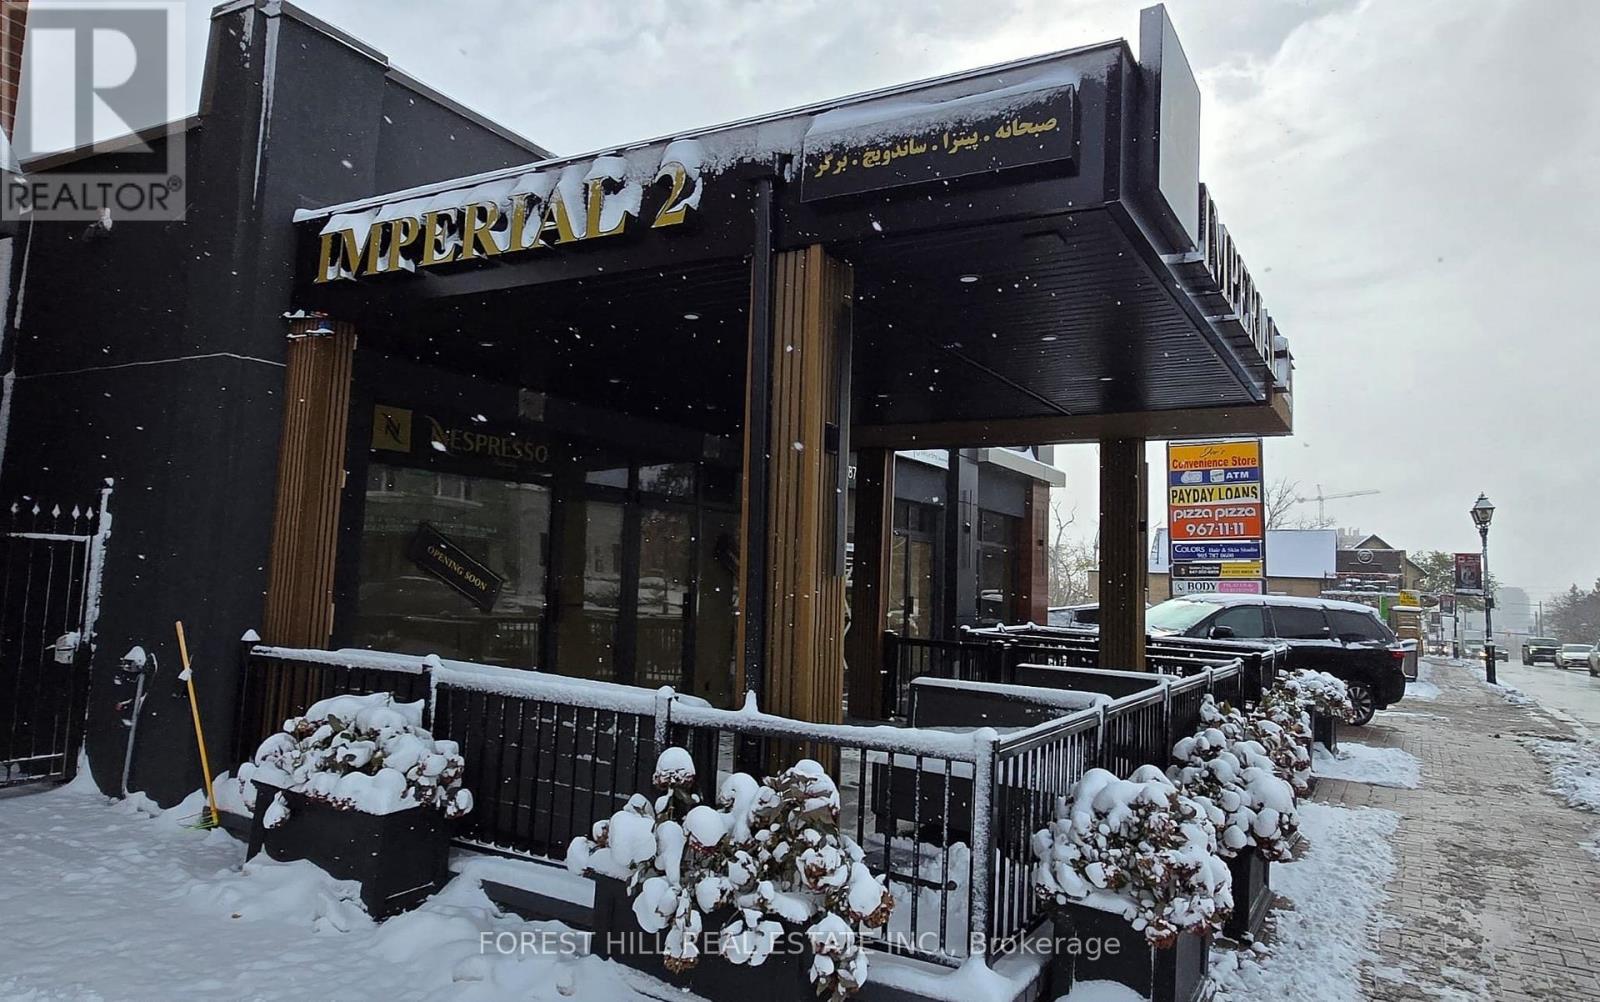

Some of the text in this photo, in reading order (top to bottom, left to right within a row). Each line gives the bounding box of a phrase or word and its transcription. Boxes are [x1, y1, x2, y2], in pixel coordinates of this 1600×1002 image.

[994, 116, 1057, 140] صبحانه
[862, 139, 927, 169] ساندویچ
[943, 130, 979, 155] پیتزا
[313, 160, 692, 284] IMPERIAL 2
[424, 415, 549, 464] NESPRESSO
[1172, 456, 1257, 470] Convenience Store
[1226, 471, 1249, 480] ATM
[1171, 485, 1258, 504] PAYDAY LOANS
[1173, 506, 1256, 522] pizza pizza
[427, 545, 488, 591] OPENING SOON
[1187, 581, 1217, 591] BODY
